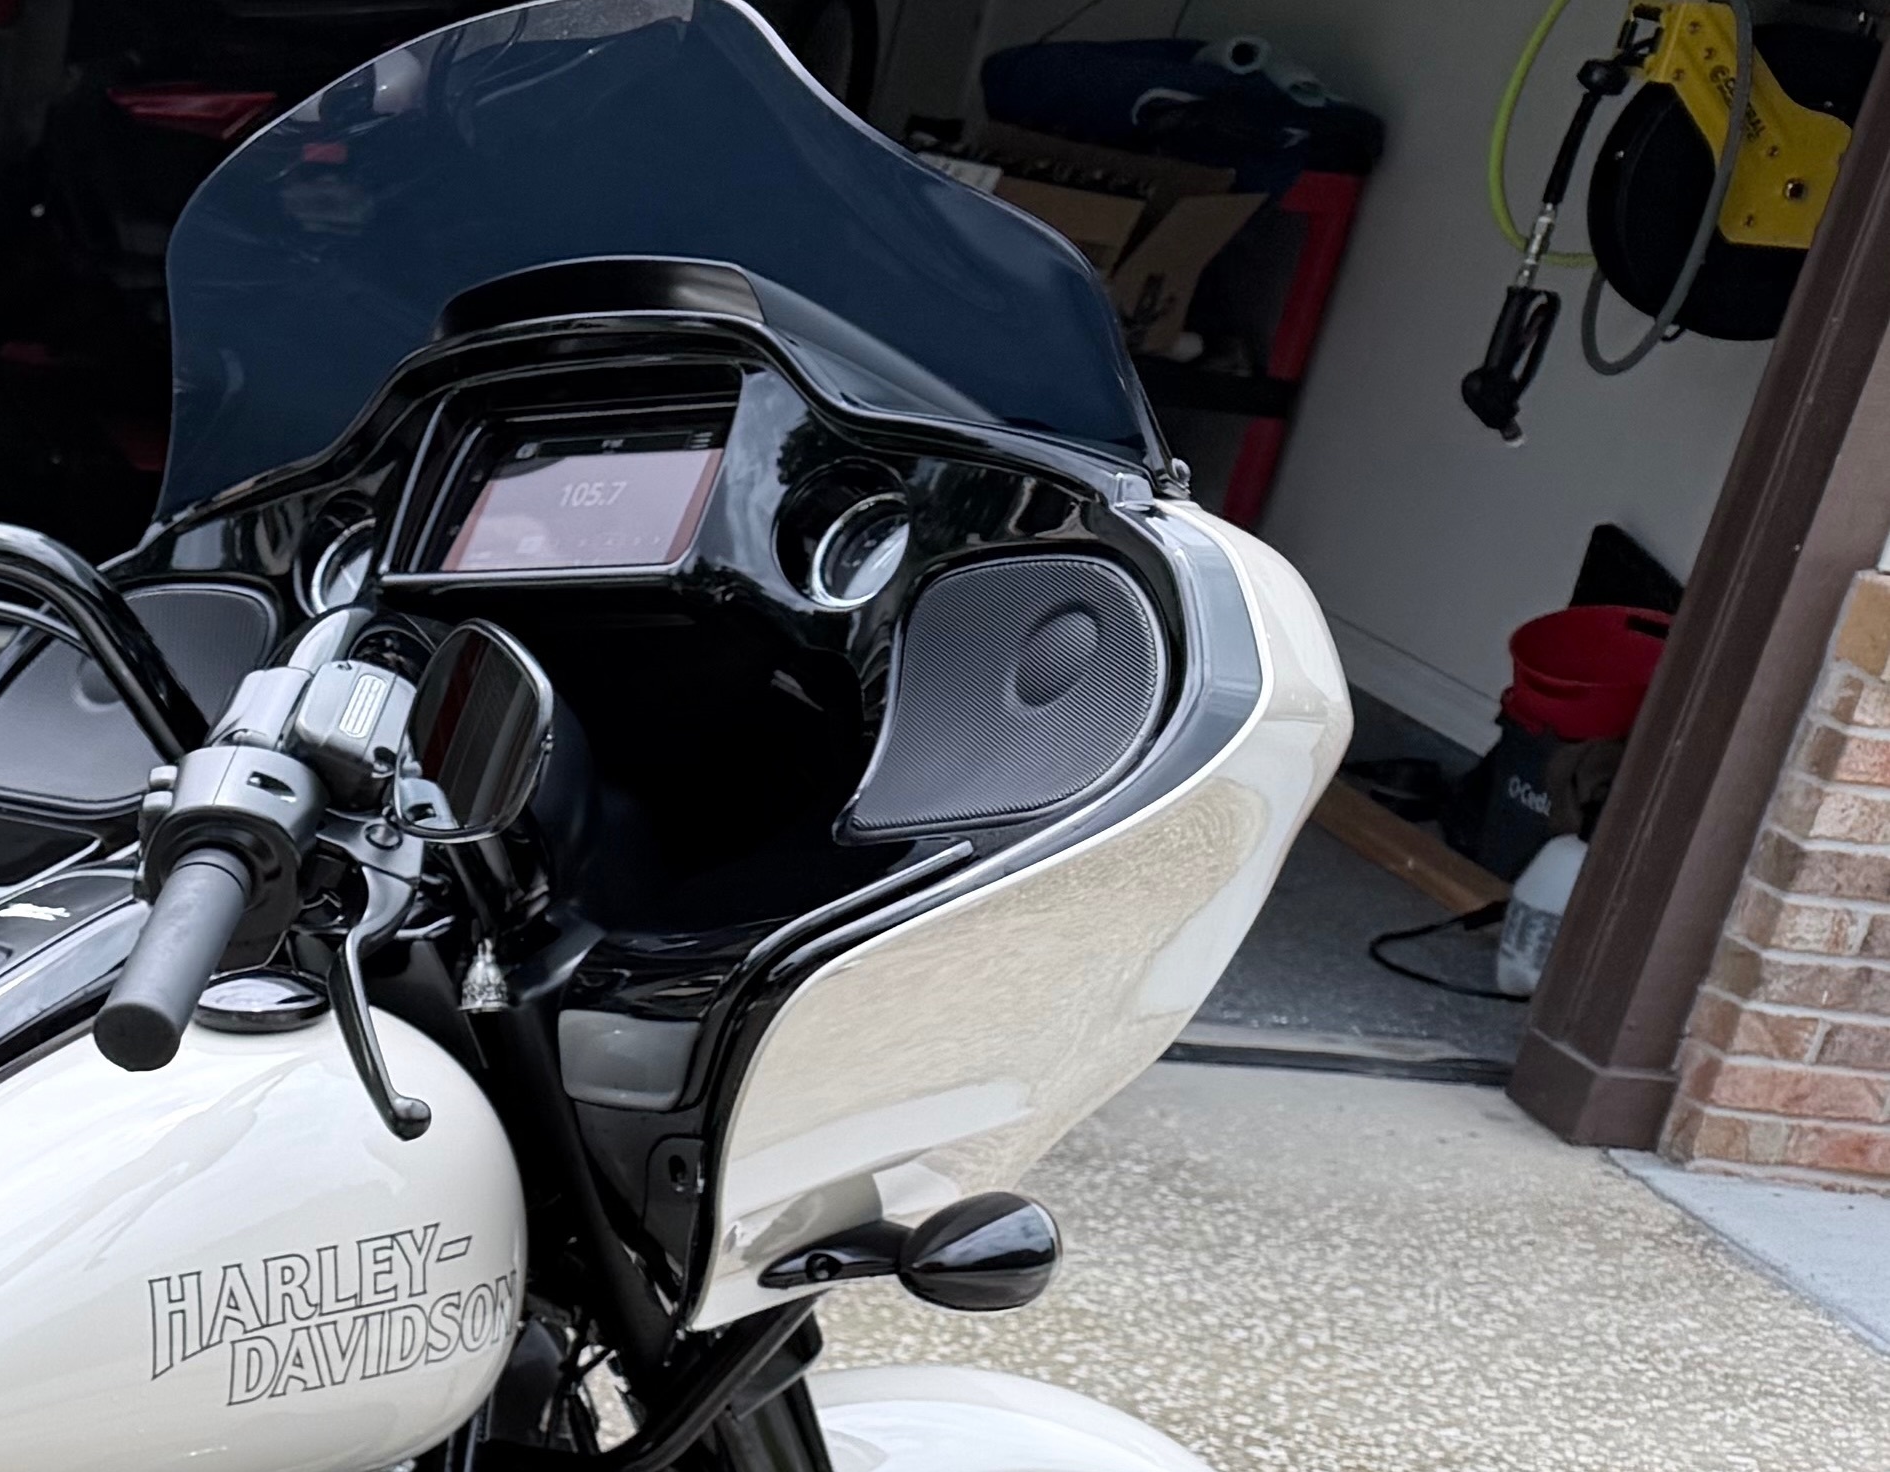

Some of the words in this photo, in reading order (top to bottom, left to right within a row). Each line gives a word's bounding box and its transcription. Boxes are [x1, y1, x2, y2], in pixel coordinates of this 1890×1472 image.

[560, 482, 627, 507] 105.7
[148, 1223, 472, 1380] HARLEY-
[226, 1268, 517, 1406] DAVIDSON
